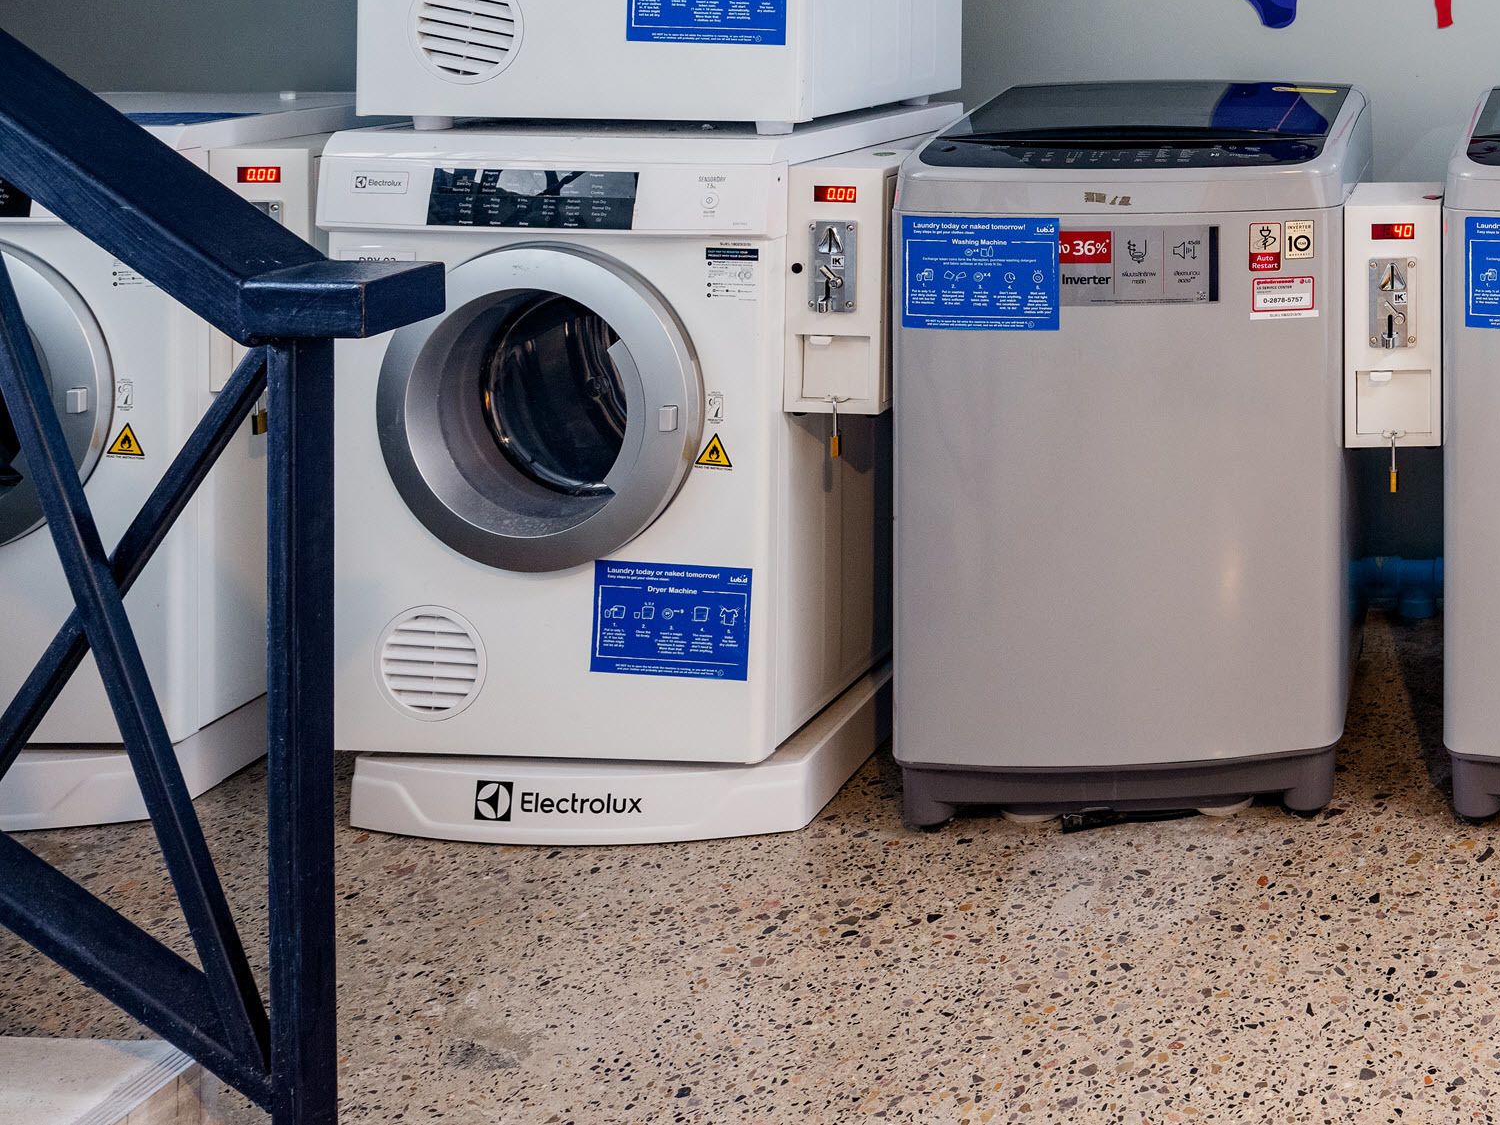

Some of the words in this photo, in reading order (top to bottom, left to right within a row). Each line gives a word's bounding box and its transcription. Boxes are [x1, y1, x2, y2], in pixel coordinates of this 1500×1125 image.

[246, 168, 276, 181] 0.00
[368, 179, 402, 187] Electrolux
[826, 187, 855, 200] 0.00
[913, 222, 940, 230] Laundry
[941, 222, 959, 230] today
[1394, 225, 1412, 238] 40
[1062, 274, 1111, 285] Inverter
[607, 567, 635, 575] Laundry
[636, 568, 654, 576] today
[686, 571, 720, 579] tomorrow!
[647, 585, 667, 594] Dryer
[668, 587, 698, 595] Machine
[520, 792, 642, 814] Electrolux
